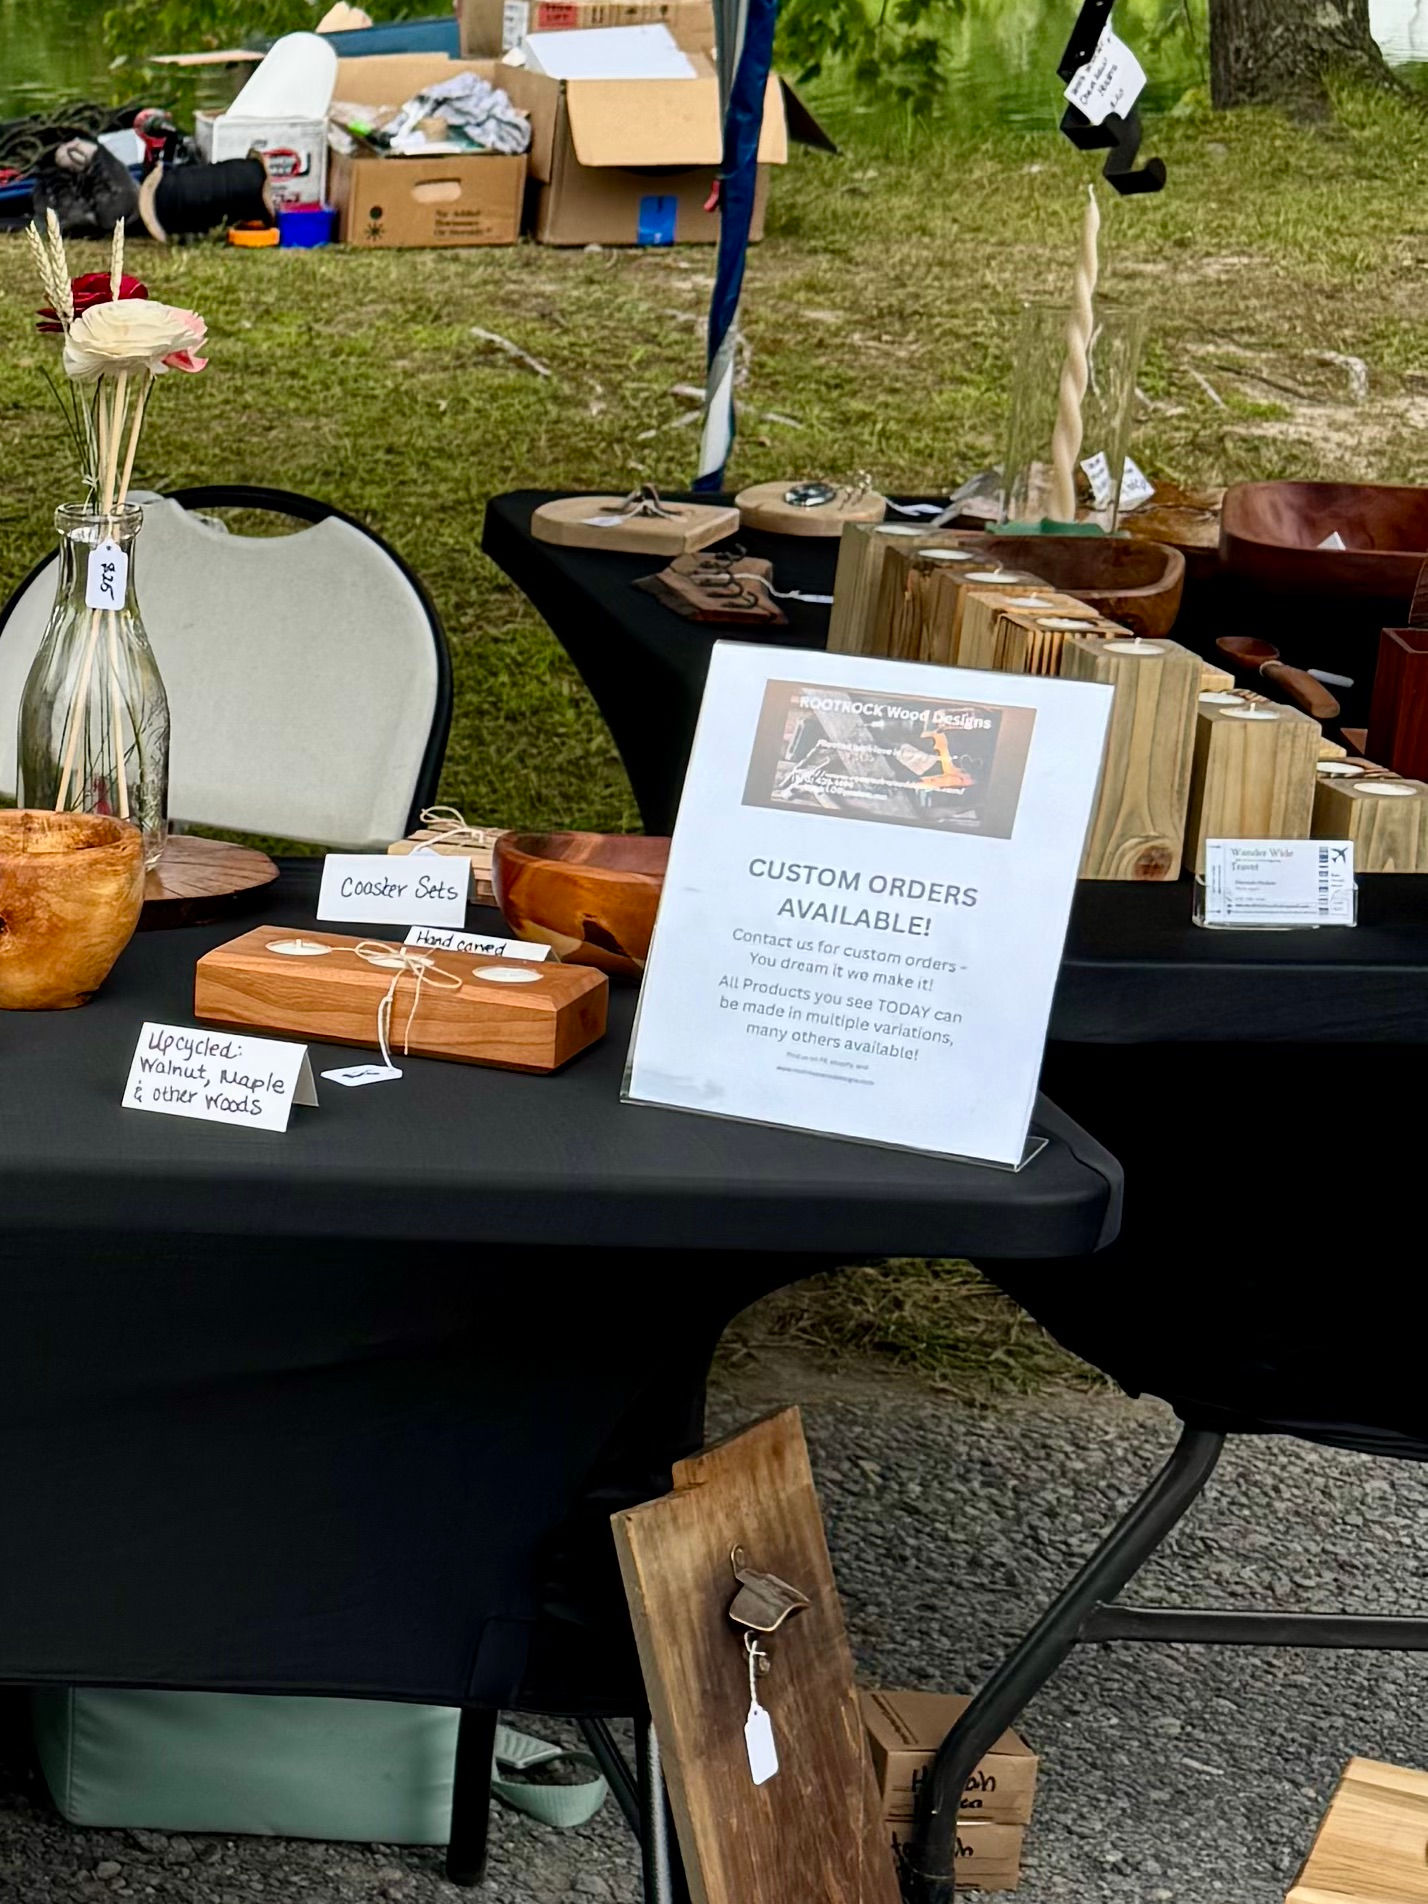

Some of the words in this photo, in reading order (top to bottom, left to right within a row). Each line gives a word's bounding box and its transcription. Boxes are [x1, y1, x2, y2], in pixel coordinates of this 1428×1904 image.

[799, 696, 885, 717] ROOTROCK
[886, 705, 929, 722] Wood
[932, 712, 992, 730] Designs
[340, 876, 409, 899] Coaster
[415, 874, 459, 901] Sets
[748, 858, 862, 893] CUSTOM
[869, 873, 978, 908] ORDERS
[777, 897, 932, 937] AVAILABLE!
[416, 930, 453, 949] Hand
[732, 928, 793, 949] Contact
[796, 939, 814, 951] us
[818, 939, 840, 955] for
[843, 946, 901, 964] custom
[905, 954, 957, 973] orders
[749, 951, 776, 968] You
[780, 957, 828, 976] dream
[832, 963, 843, 978] it
[847, 969, 869, 981] we
[872, 972, 914, 989] make
[918, 978, 934, 992] it!
[718, 974, 739, 989] All
[743, 978, 811, 1001] Products
[813, 991, 842, 1006] you
[846, 997, 873, 1010] see
[878, 999, 931, 1019] TODAY
[934, 1010, 962, 1024] can
[720, 995, 739, 1011] be
[743, 999, 785, 1018] made
[789, 1006, 801, 1020] in
[806, 1011, 869, 1032] multiple
[874, 1023, 954, 1047] variations,
[746, 1024, 788, 1043] many
[791, 1030, 841, 1049] others
[844, 1038, 919, 1061] available!
[152, 1084, 197, 1106] other
